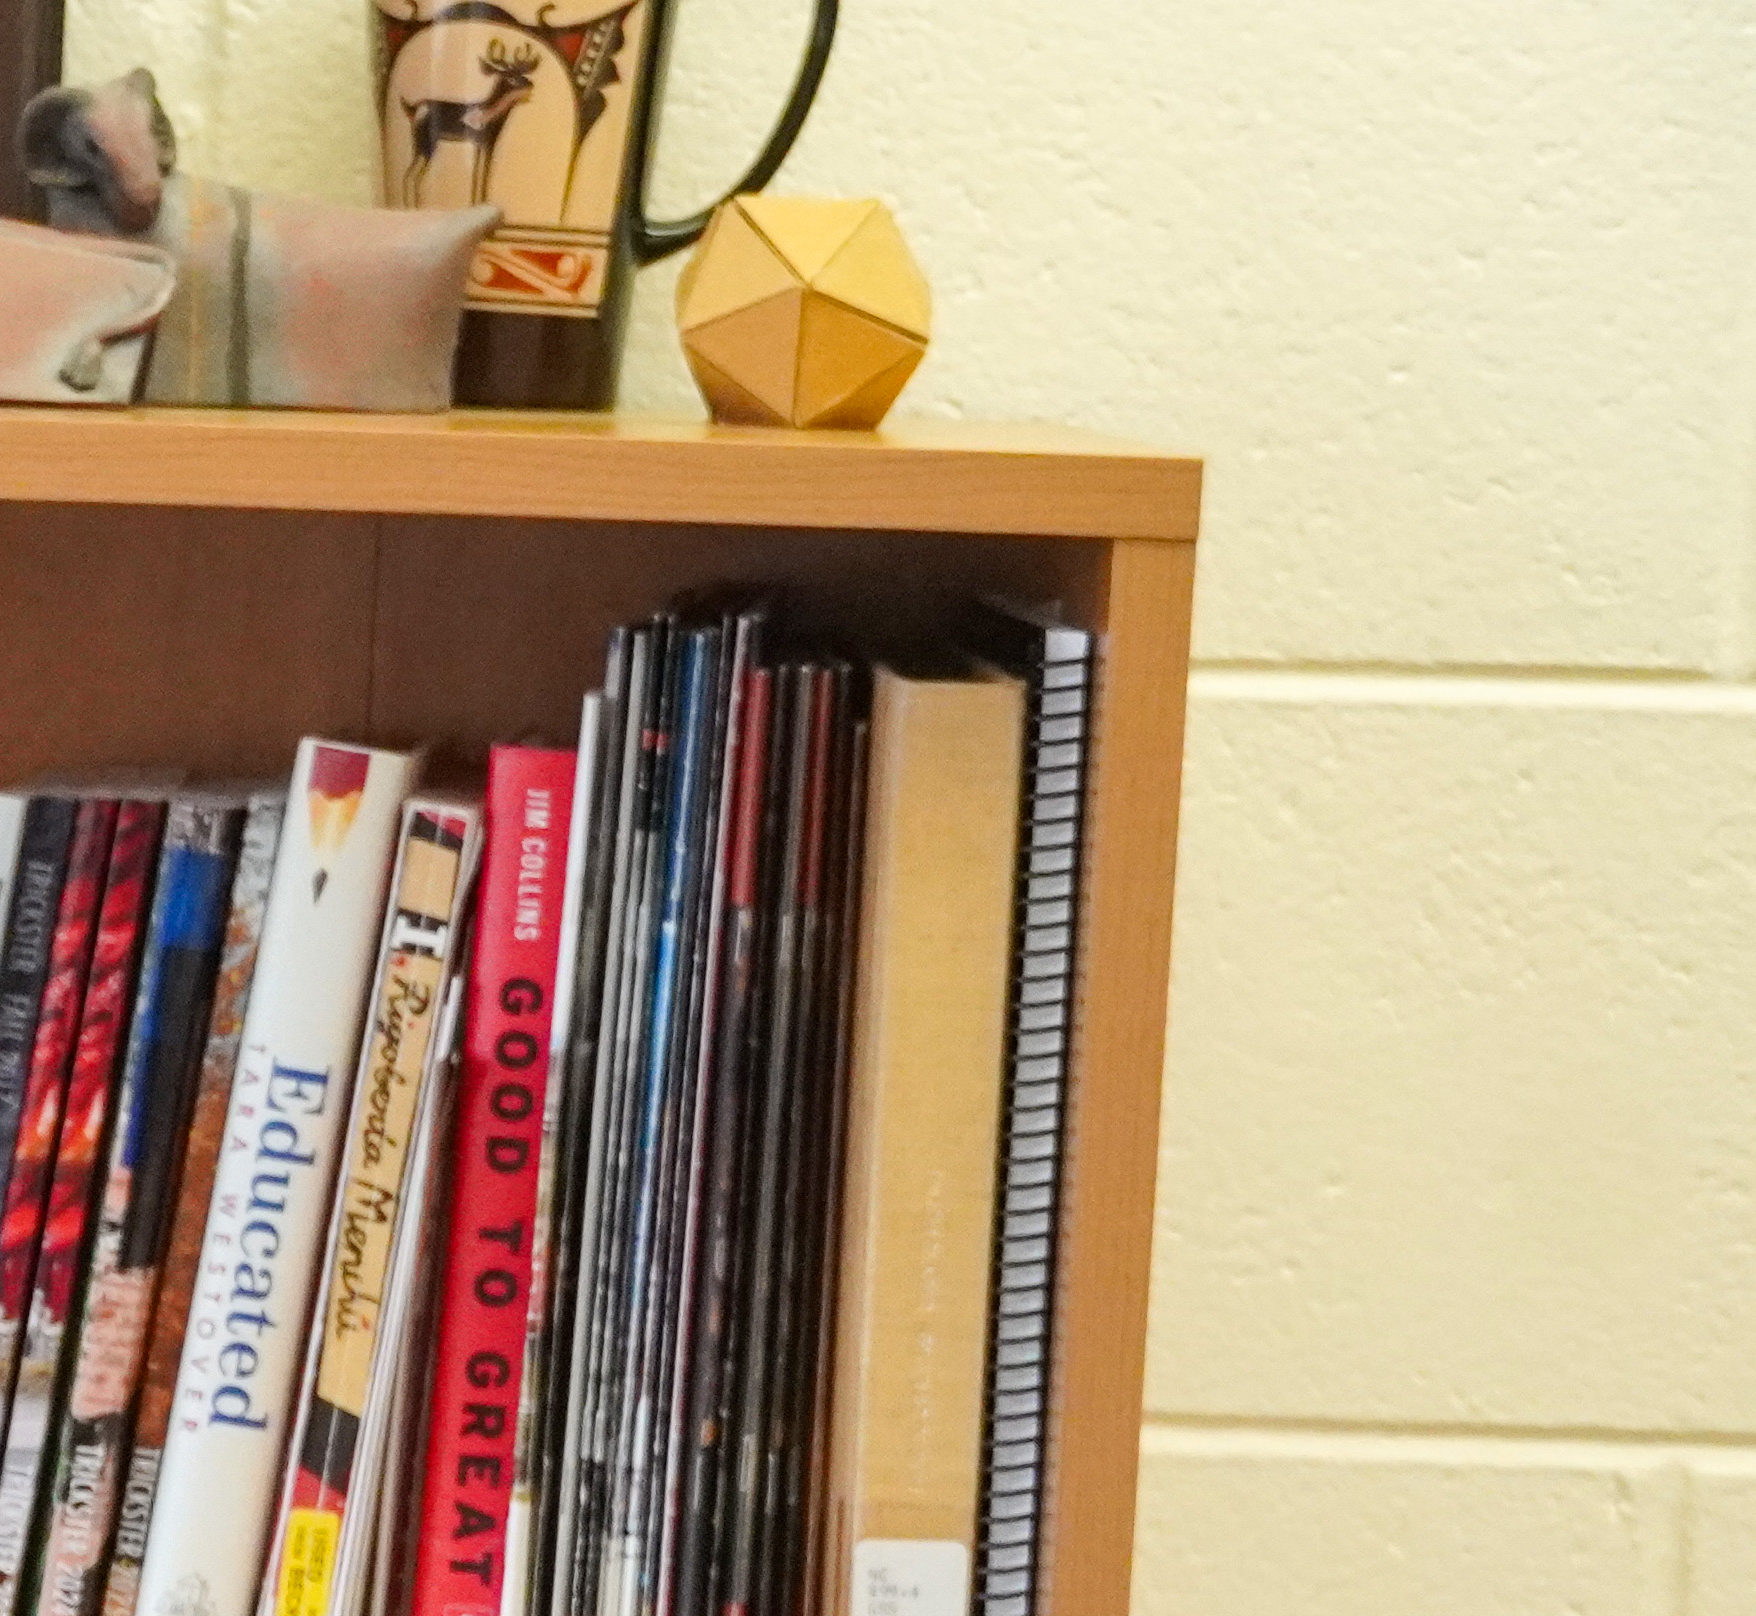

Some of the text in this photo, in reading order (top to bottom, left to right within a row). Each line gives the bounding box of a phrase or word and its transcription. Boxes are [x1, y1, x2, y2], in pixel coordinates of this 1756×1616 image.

[8, 859, 56, 974] TRICKSTER
[513, 787, 552, 942] JIM COLLINS
[361, 975, 431, 1169] Rigoberta
[184, 1042, 270, 1432] TARA WESTOVER
[207, 1056, 331, 1431] Educated
[449, 976, 544, 1588] GOOD TO GREAT
[60, 1444, 107, 1557] TRICKSTER
[114, 1447, 161, 1558] TRICKSTER
